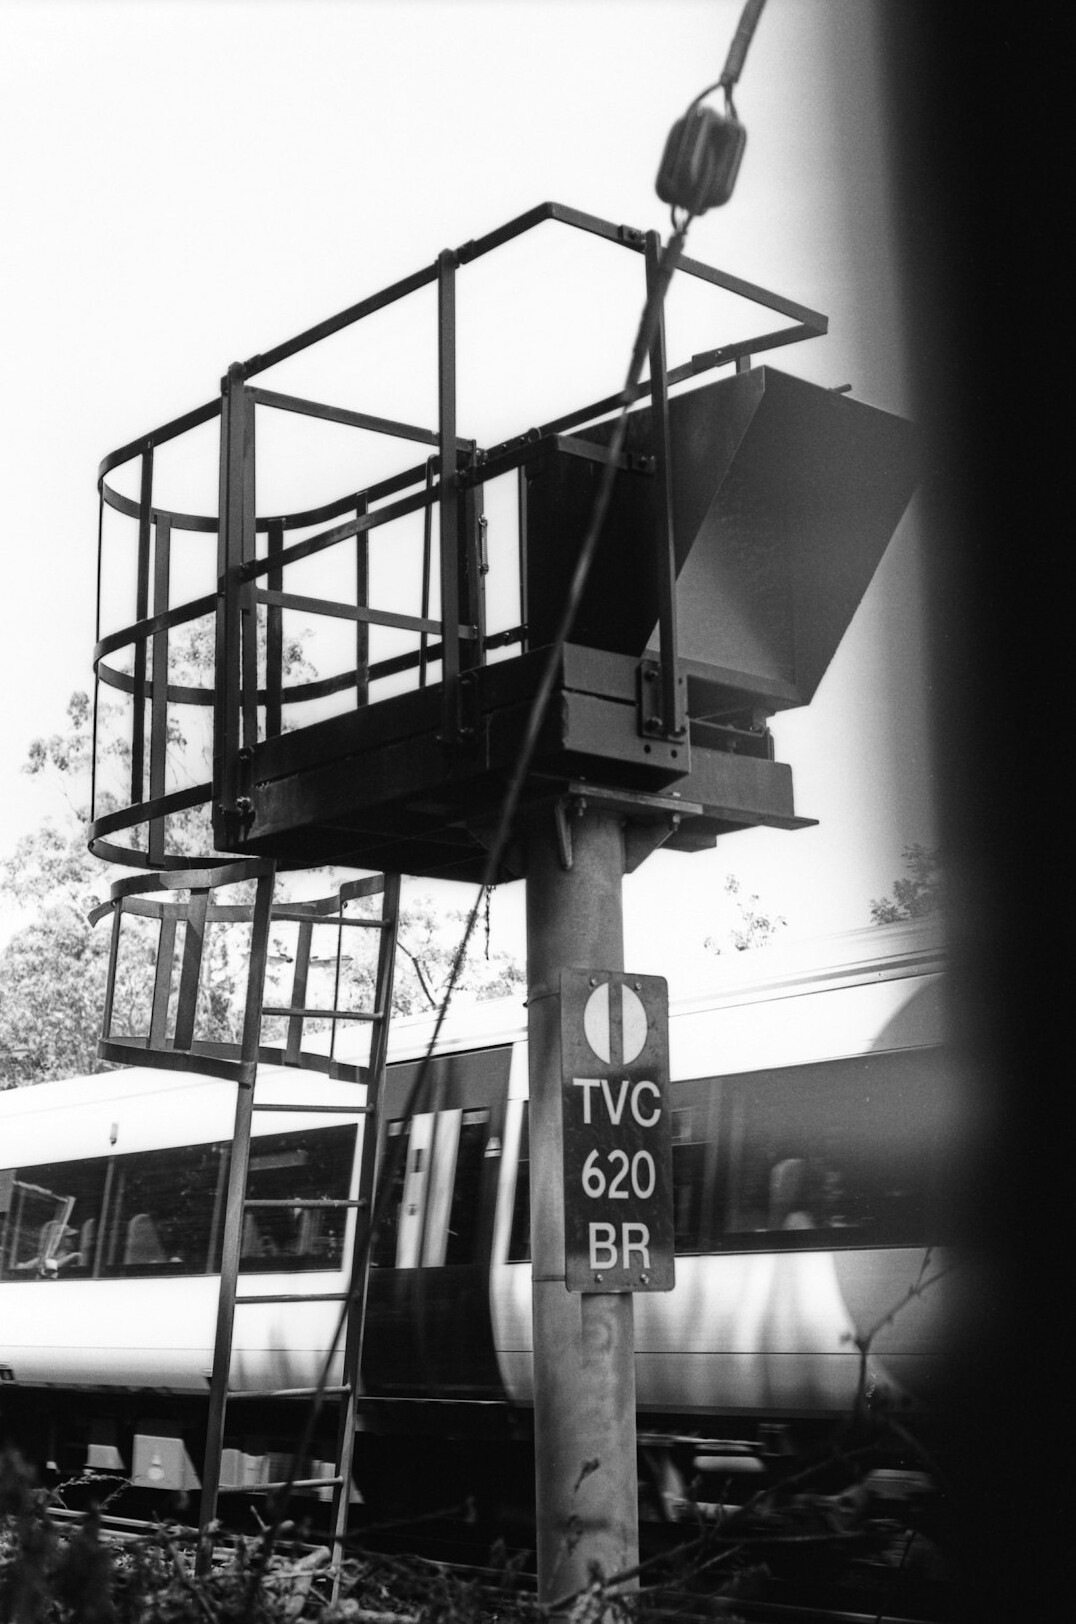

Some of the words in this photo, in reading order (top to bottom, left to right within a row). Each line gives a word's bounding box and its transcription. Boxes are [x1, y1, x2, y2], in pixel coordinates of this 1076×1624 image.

[572, 1077, 662, 1128] TVC
[581, 1148, 656, 1199] 620
[588, 1221, 651, 1270] BR
